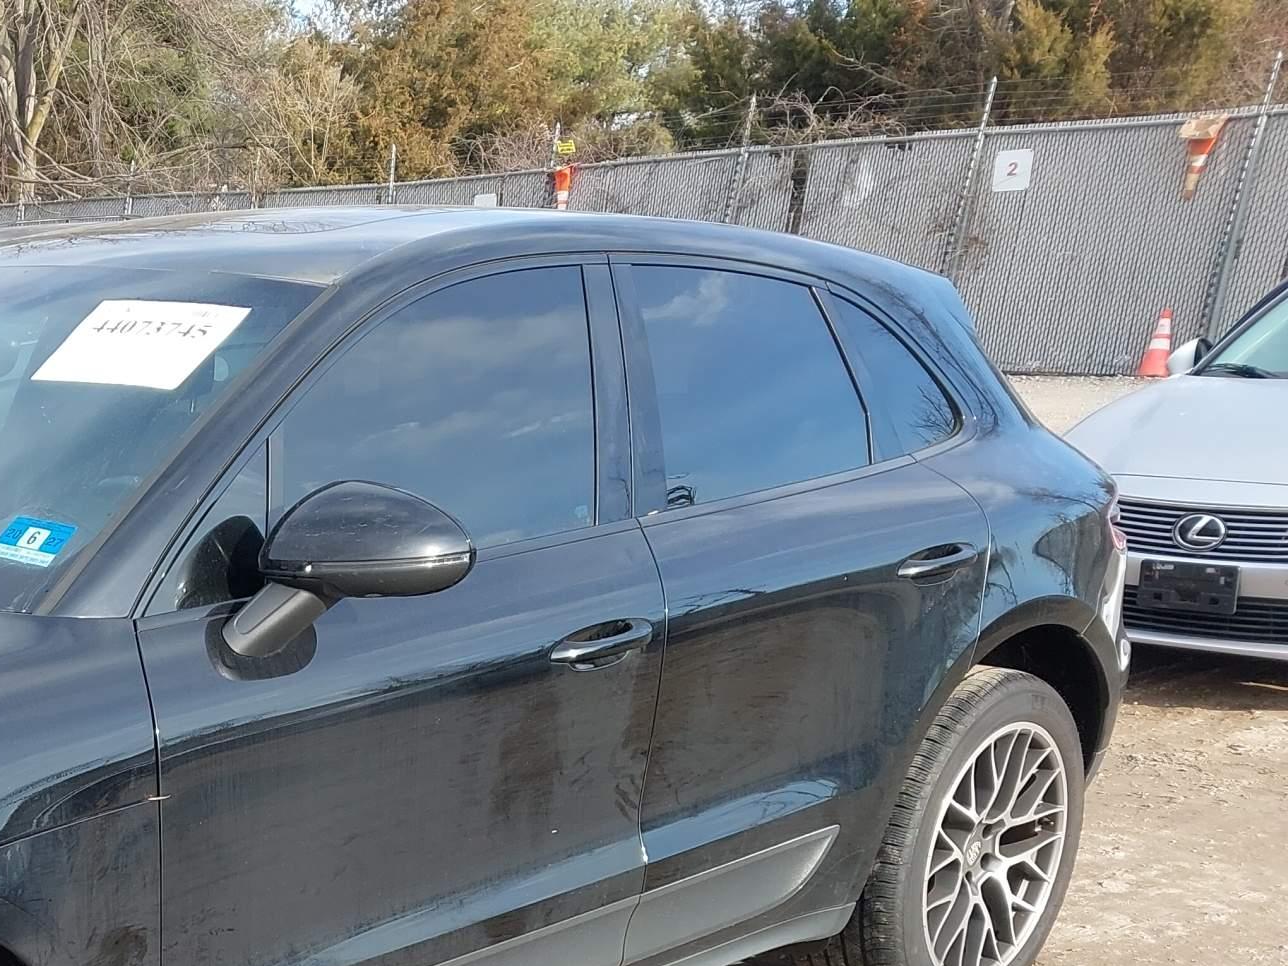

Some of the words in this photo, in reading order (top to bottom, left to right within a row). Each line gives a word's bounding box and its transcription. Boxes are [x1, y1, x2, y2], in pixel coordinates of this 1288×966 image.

[1007, 161, 1018, 177] 2
[91, 319, 214, 339] 44073745
[26, 530, 41, 545] 6
